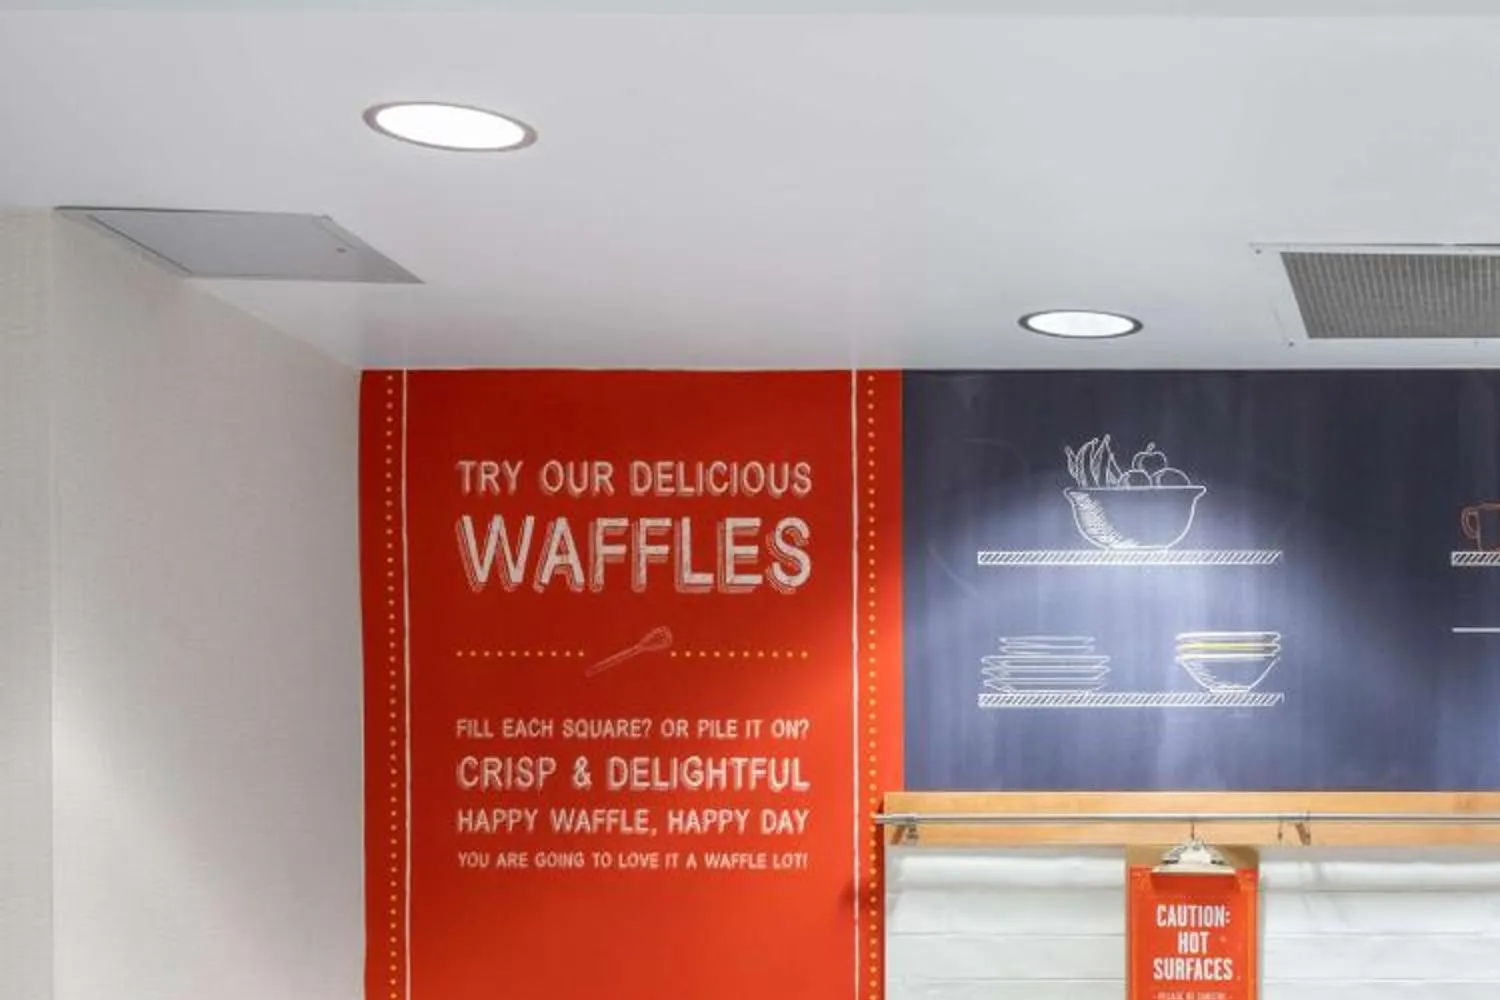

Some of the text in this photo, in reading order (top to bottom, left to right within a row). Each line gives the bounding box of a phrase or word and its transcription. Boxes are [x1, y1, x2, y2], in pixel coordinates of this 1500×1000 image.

[456, 460, 813, 498] TRY OUR DELICIOUS
[455, 514, 812, 595] WAFFLES
[456, 718, 810, 739] FILL EACH SQUARE? OR PILE IT ON?
[456, 755, 811, 791] CRISP & DELIGHTFUL
[456, 808, 810, 836] HAPPY WAFFLE, HAPPY DAY
[457, 852, 809, 869] YOU ARE GOING TO LOVE IT A WAFFLE LOT!
[1156, 904, 1231, 927] CAUTION:
[1177, 932, 1210, 954] HOT
[1153, 957, 1233, 981] SURFACES
